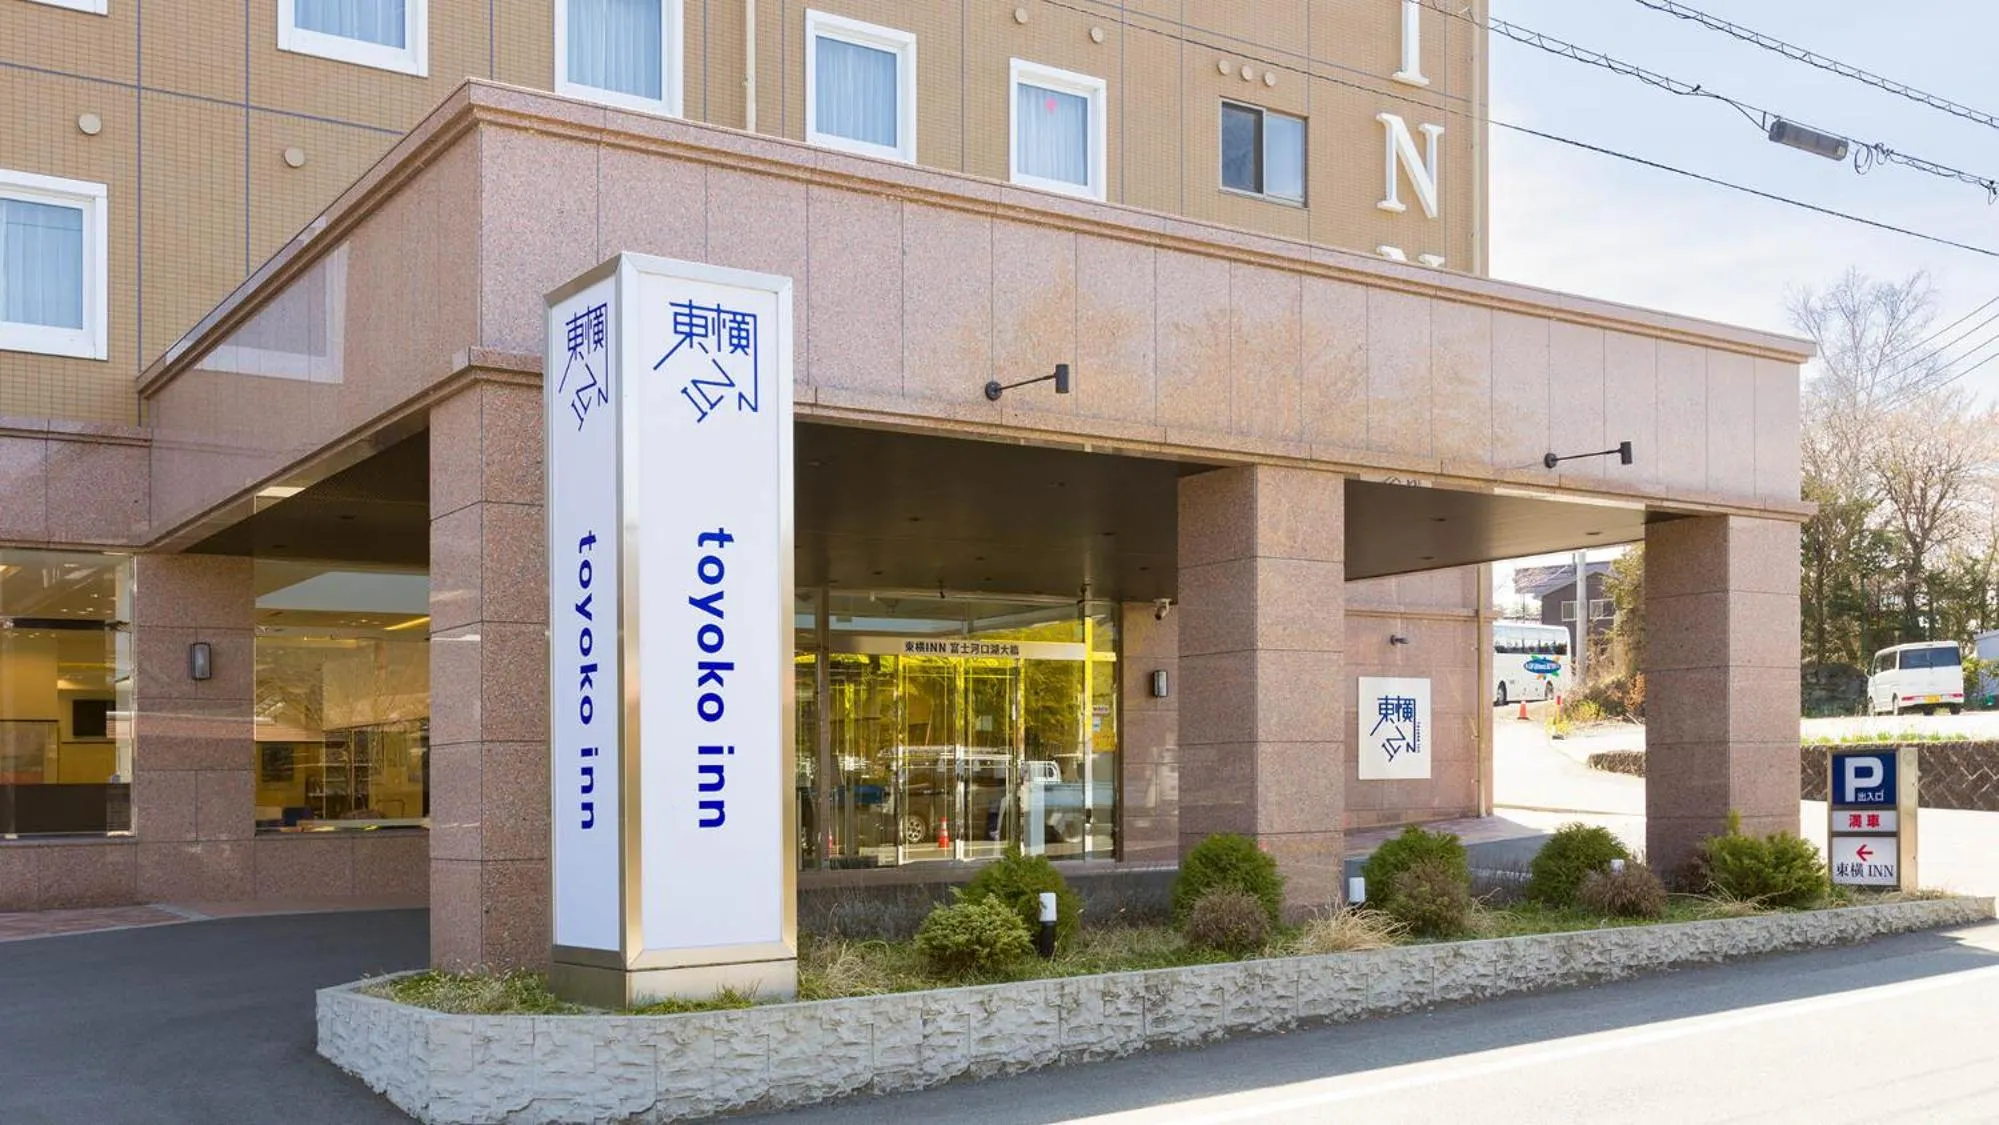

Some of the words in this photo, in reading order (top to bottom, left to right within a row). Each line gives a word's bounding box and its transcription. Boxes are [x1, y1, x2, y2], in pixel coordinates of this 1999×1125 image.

[1375, 0, 1445, 266] IN
[575, 530, 598, 725] toyoko
[688, 527, 735, 722] toyoko
[580, 747, 599, 829] inn
[697, 745, 735, 828] inn
[1844, 756, 1884, 803] P
[1857, 790, 1884, 802] 出入口
[1849, 814, 1880, 828] 満車
